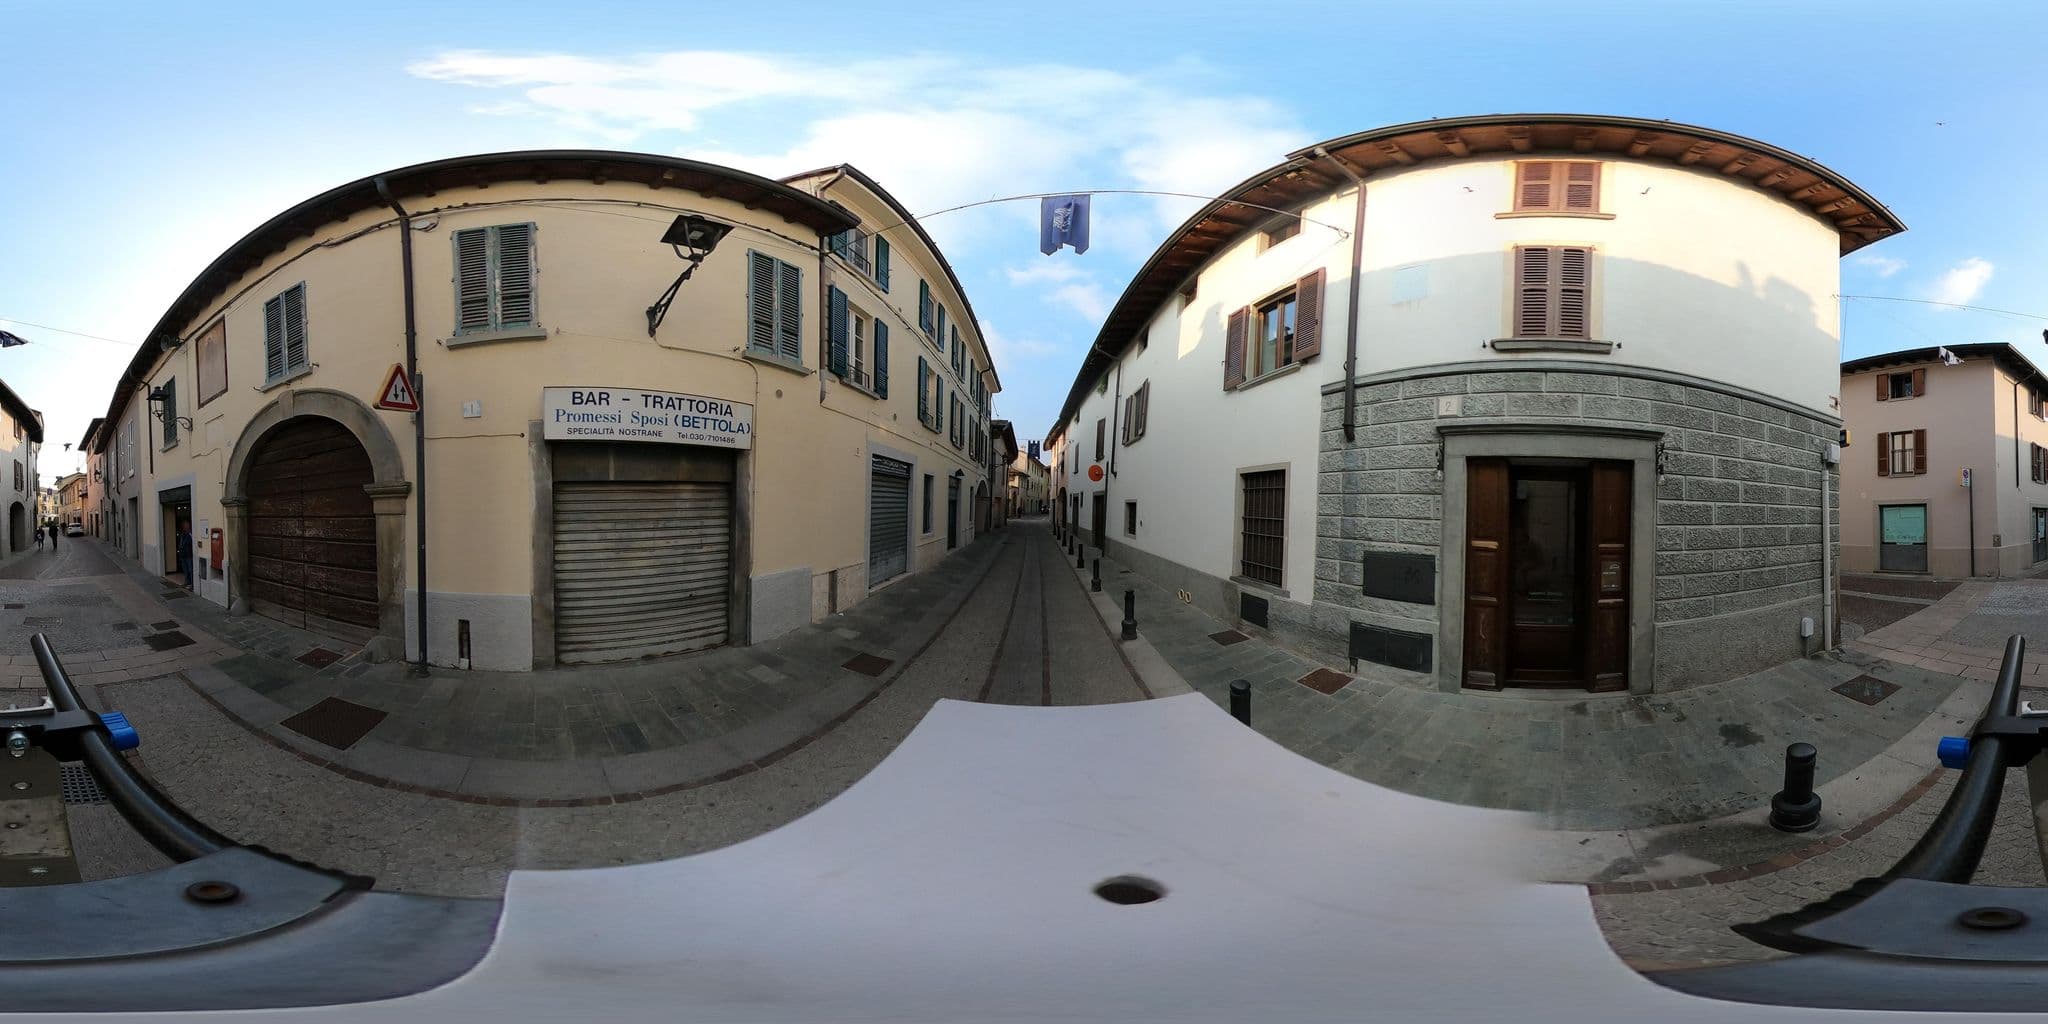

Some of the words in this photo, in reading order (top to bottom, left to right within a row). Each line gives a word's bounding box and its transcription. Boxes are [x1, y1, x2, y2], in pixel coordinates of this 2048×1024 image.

[572, 391, 610, 406] BAR
[641, 394, 734, 418] TRATTORIA
[555, 408, 622, 424] Promessi
[631, 410, 668, 427] Sposi
[674, 414, 751, 435] (BETTOLA)
[567, 426, 614, 435] SPECIALITÀ
[619, 428, 664, 438] NOSTRANE
